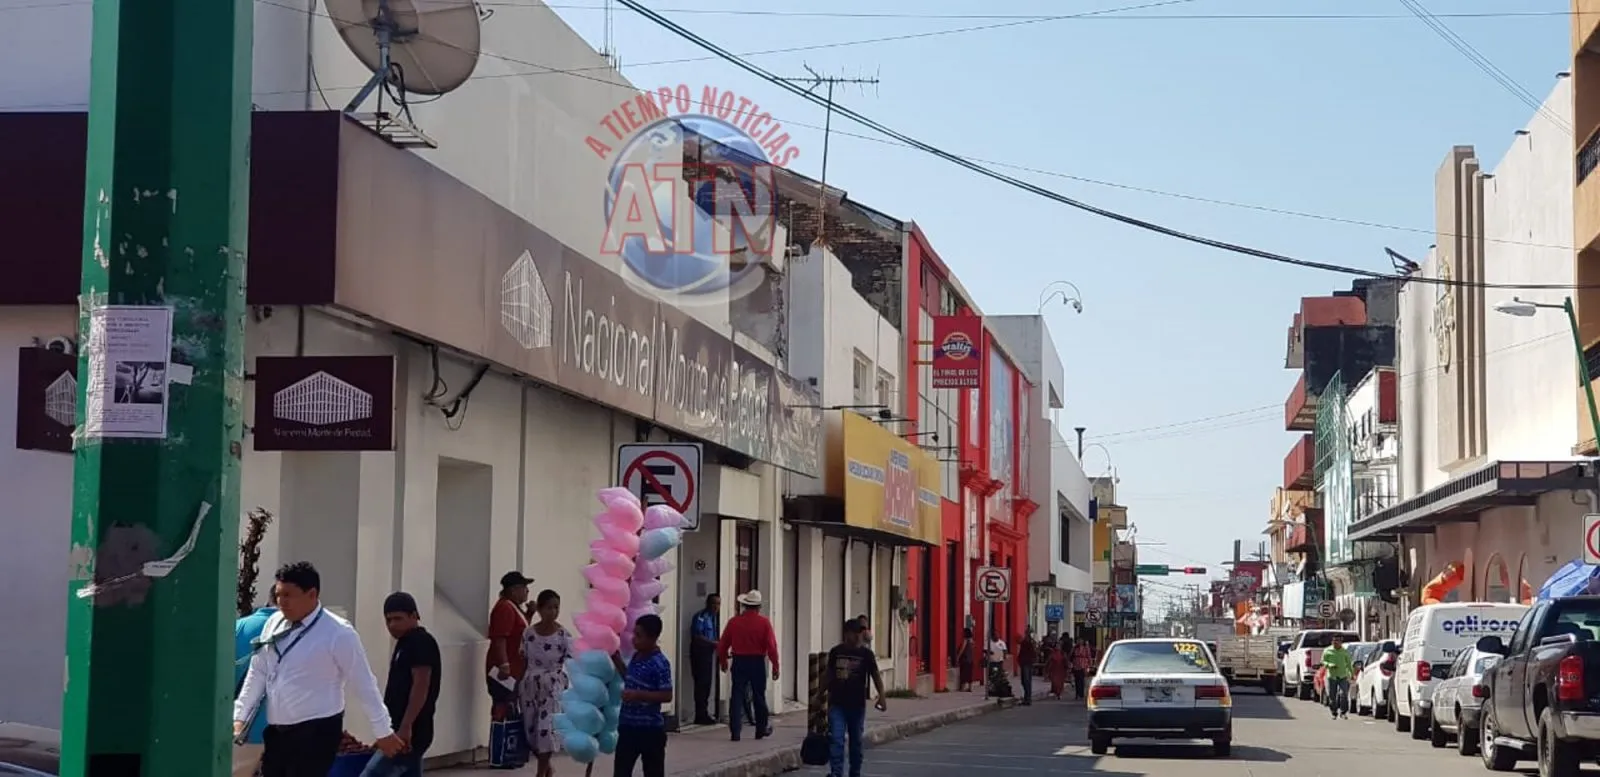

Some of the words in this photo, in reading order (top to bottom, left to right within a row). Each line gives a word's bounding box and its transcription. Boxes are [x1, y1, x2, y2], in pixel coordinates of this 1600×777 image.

[563, 270, 656, 397] Nacional
[659, 320, 709, 420] Monte
[1173, 643, 1198, 653] 1222
